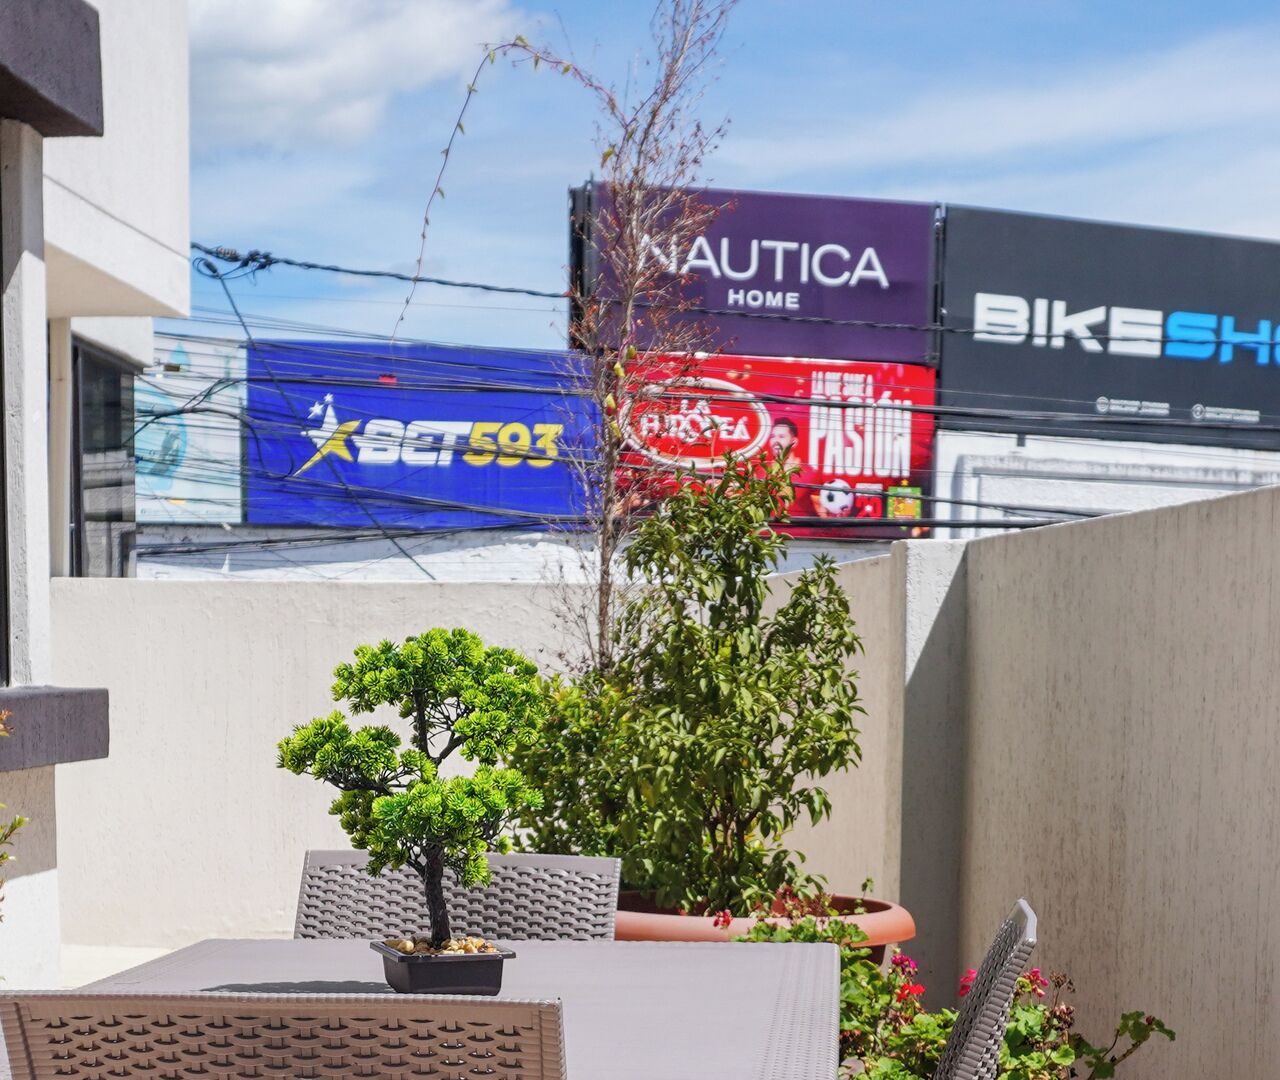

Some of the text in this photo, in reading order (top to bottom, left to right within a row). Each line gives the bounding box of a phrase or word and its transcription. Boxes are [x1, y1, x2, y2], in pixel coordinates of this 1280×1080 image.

[637, 233, 890, 289] NAUTICA
[727, 288, 801, 311] HOME
[679, 399, 712, 414] LA
[808, 390, 913, 478] PASIÓN
